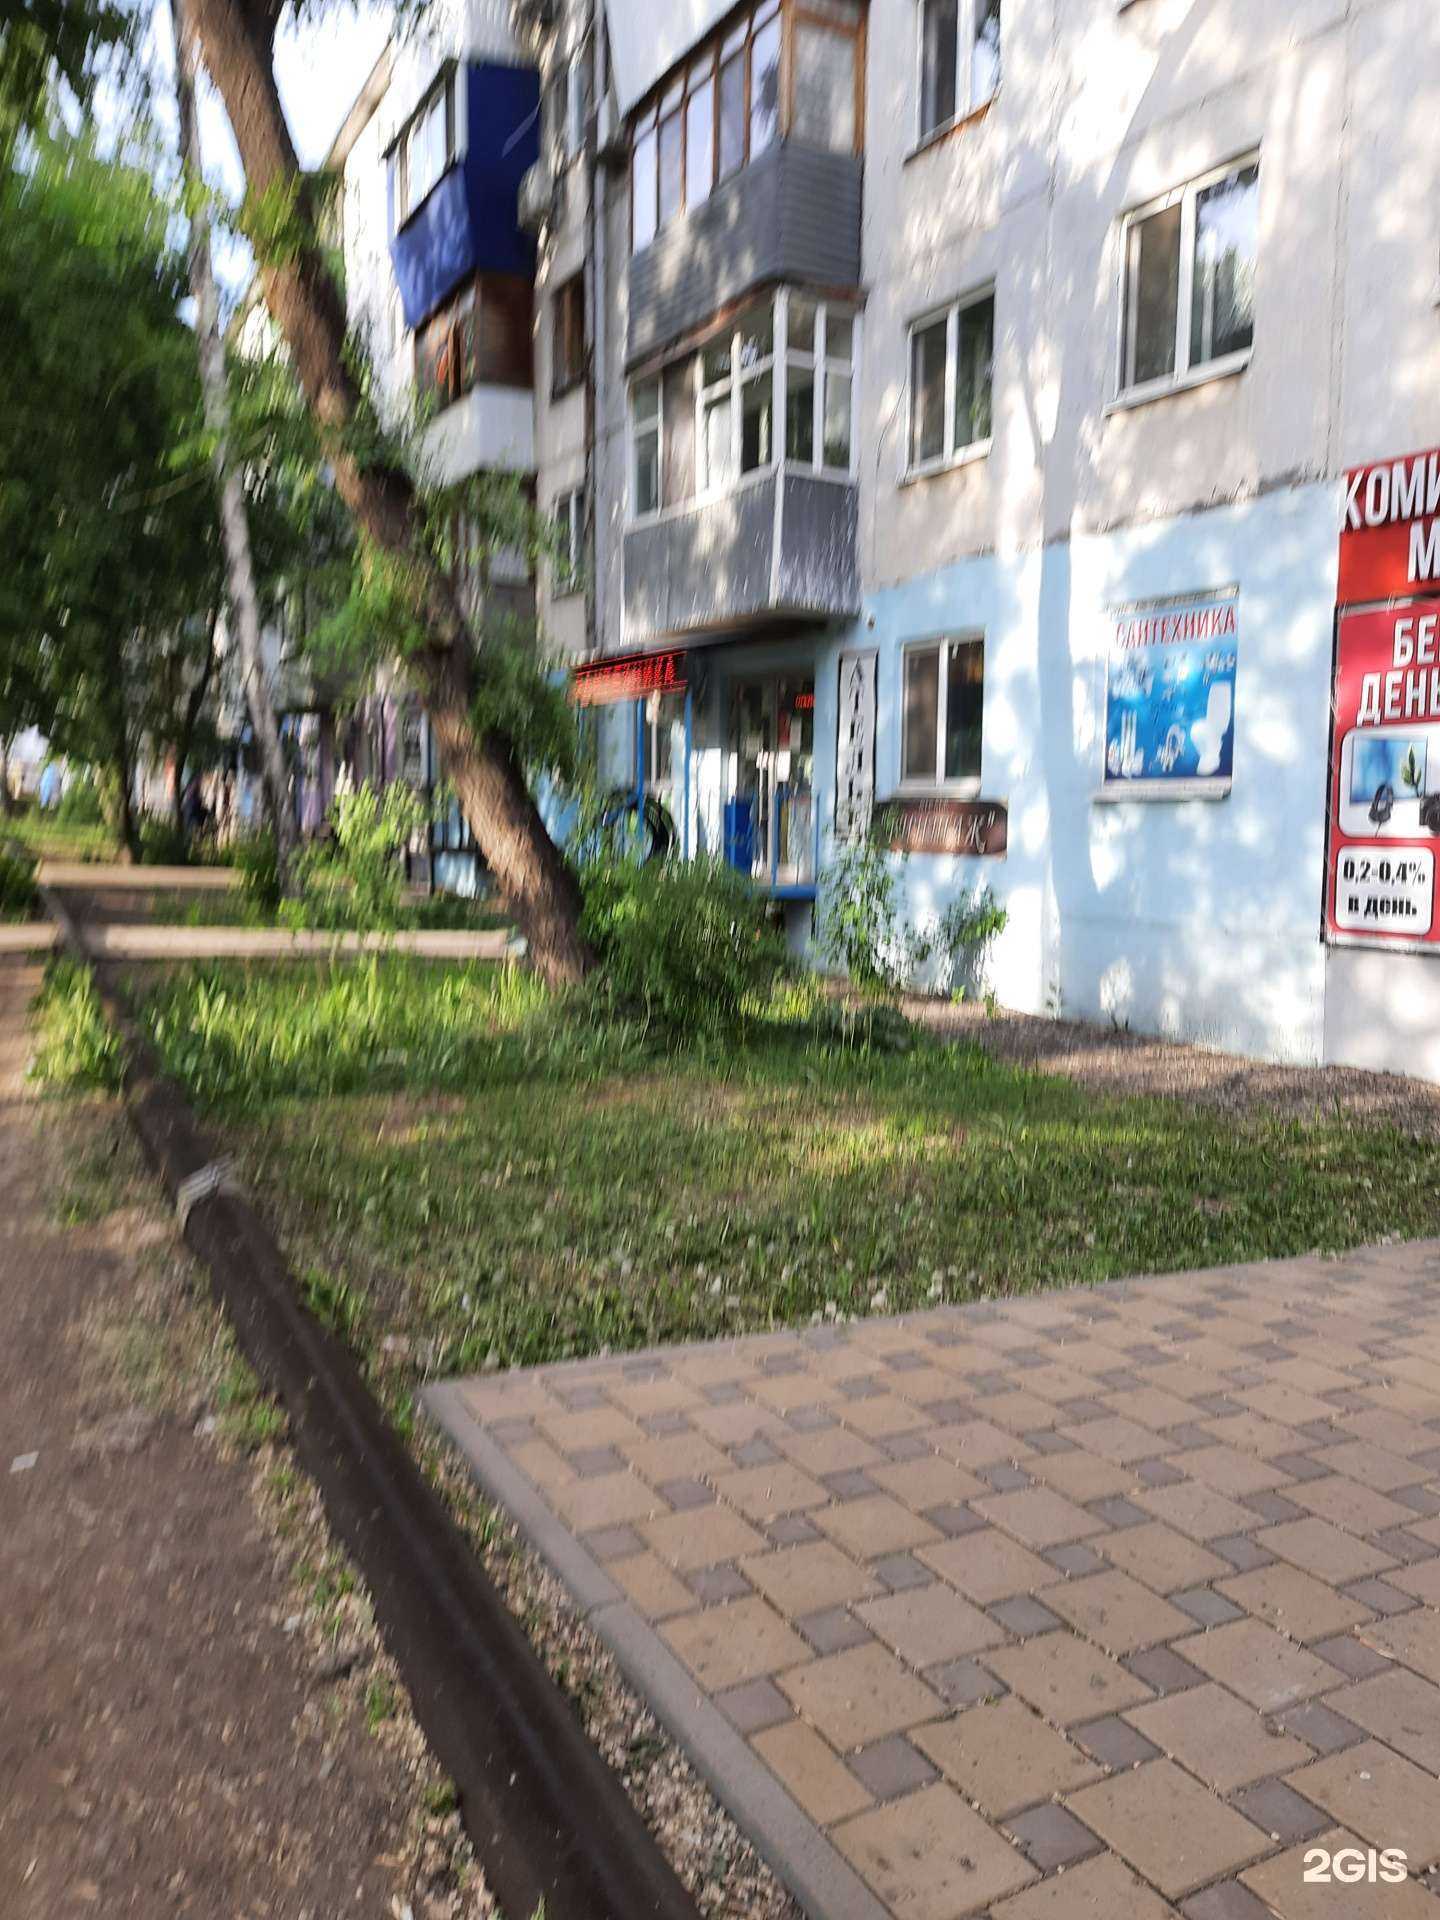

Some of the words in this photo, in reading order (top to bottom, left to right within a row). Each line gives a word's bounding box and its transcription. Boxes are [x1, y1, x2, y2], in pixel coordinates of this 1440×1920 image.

[1117, 606, 1236, 648] САНТЕХНИКА
[1392, 614, 1440, 668] БЕ
[1364, 896, 1417, 919] день
